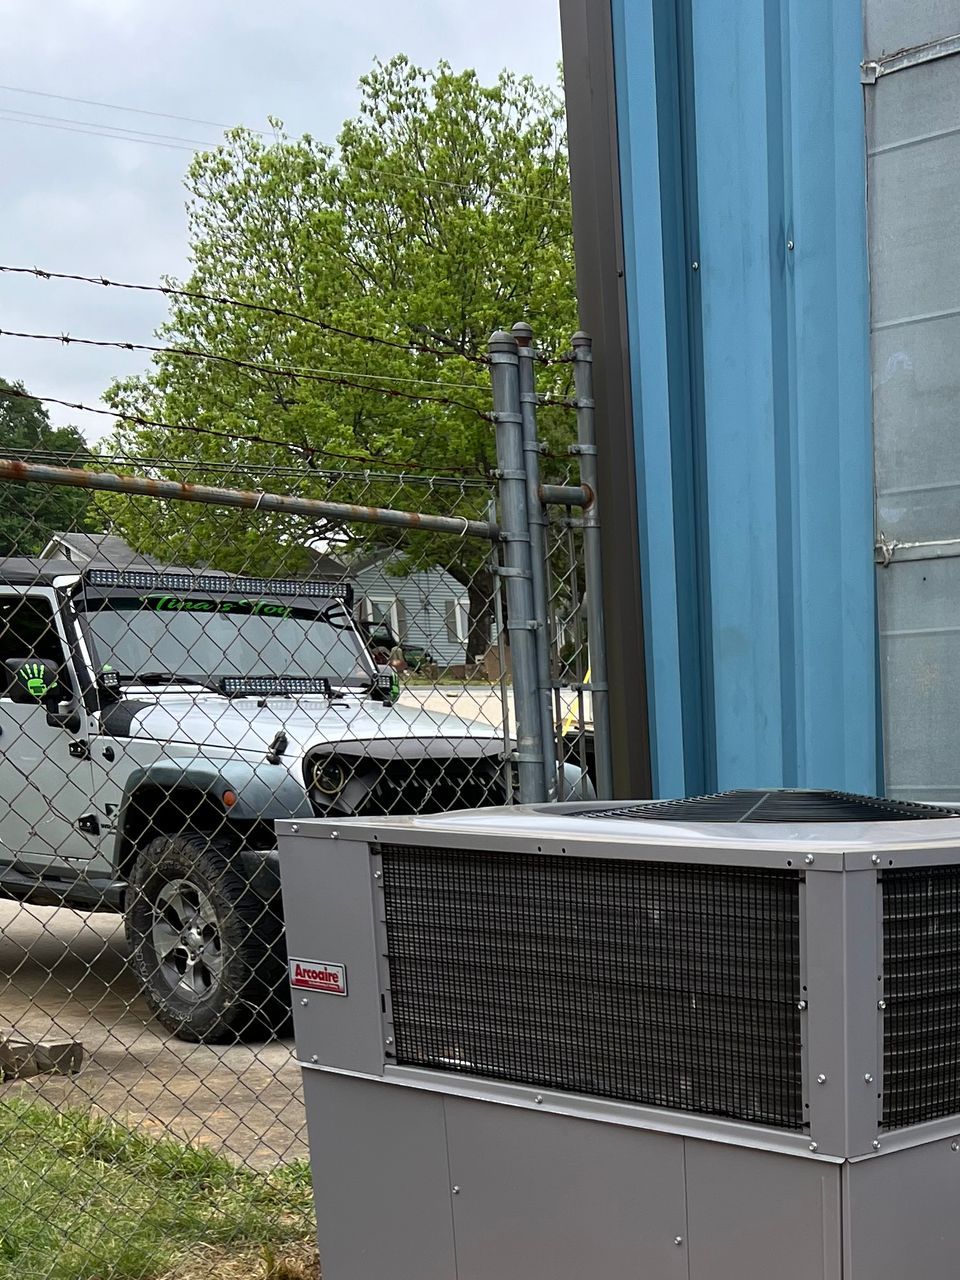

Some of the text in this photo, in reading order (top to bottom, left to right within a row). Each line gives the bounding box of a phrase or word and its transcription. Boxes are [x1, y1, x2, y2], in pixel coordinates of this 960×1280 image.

[139, 593, 293, 622] Tinas Toy
[295, 963, 340, 983] Arcoaire
